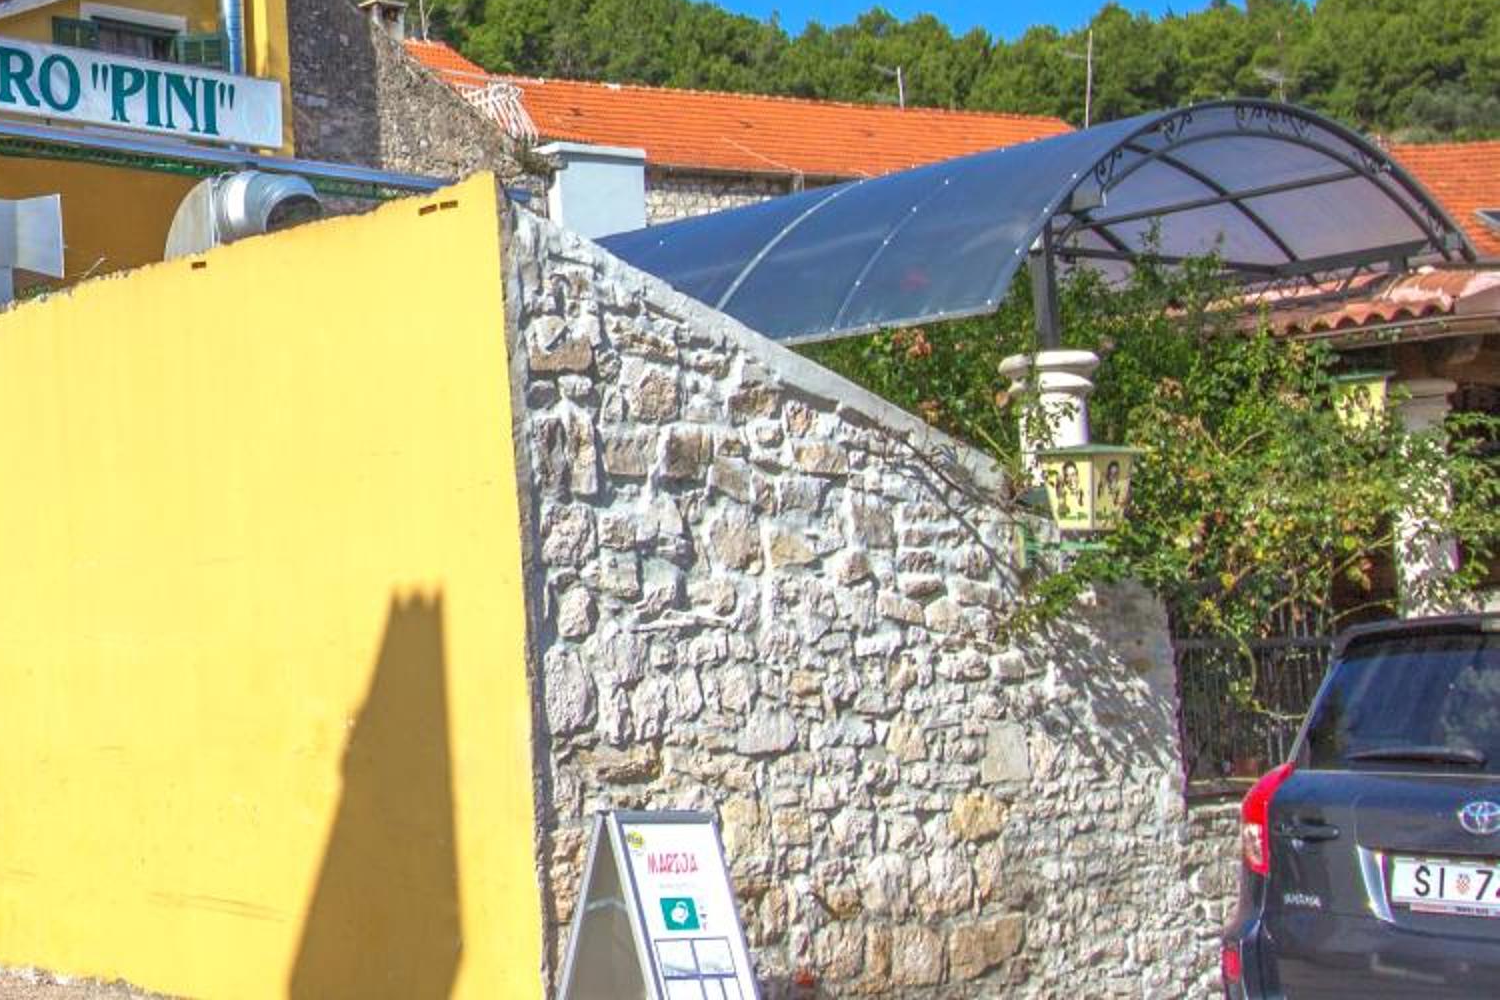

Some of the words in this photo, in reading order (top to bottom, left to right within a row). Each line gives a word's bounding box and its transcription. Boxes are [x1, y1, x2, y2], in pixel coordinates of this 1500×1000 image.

[92, 62, 235, 135] "PINI"
[1413, 865, 1446, 898] SI
[1475, 869, 1500, 901] 7
